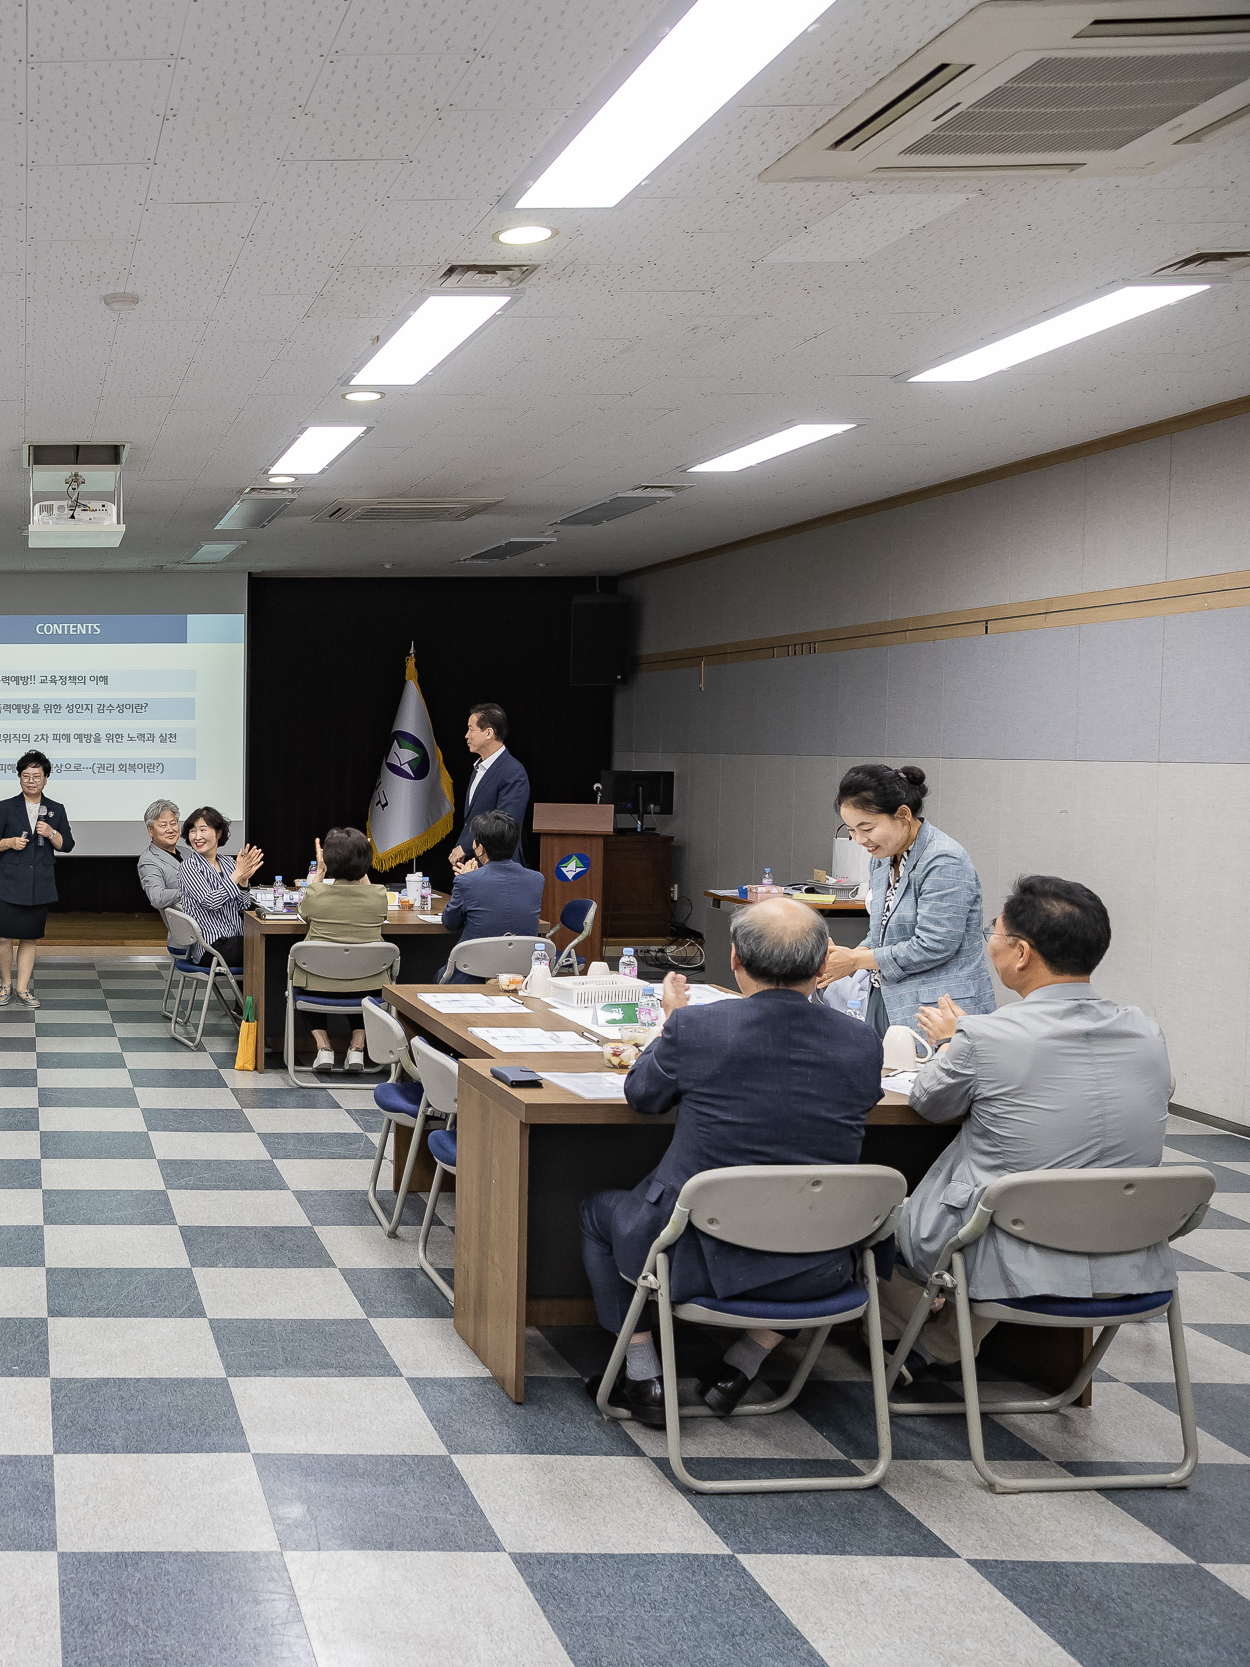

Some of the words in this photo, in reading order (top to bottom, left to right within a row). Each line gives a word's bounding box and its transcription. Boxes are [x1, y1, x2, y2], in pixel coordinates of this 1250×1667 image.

[35, 623, 101, 635] CONTENTS
[38, 675, 86, 686] 교육정책의
[89, 675, 109, 686] 이해
[43, 703, 62, 714] 위한
[65, 703, 93, 714] 성인지
[96, 702, 148, 714] 감수성이란?
[33, 733, 50, 744] 2차
[51, 733, 71, 744] 피해
[73, 733, 102, 744] 예방을
[104, 733, 124, 744] 위한
[126, 733, 155, 744] 노력과
[158, 733, 177, 744] 실천
[117, 762, 164, 774] 회복이란?)
